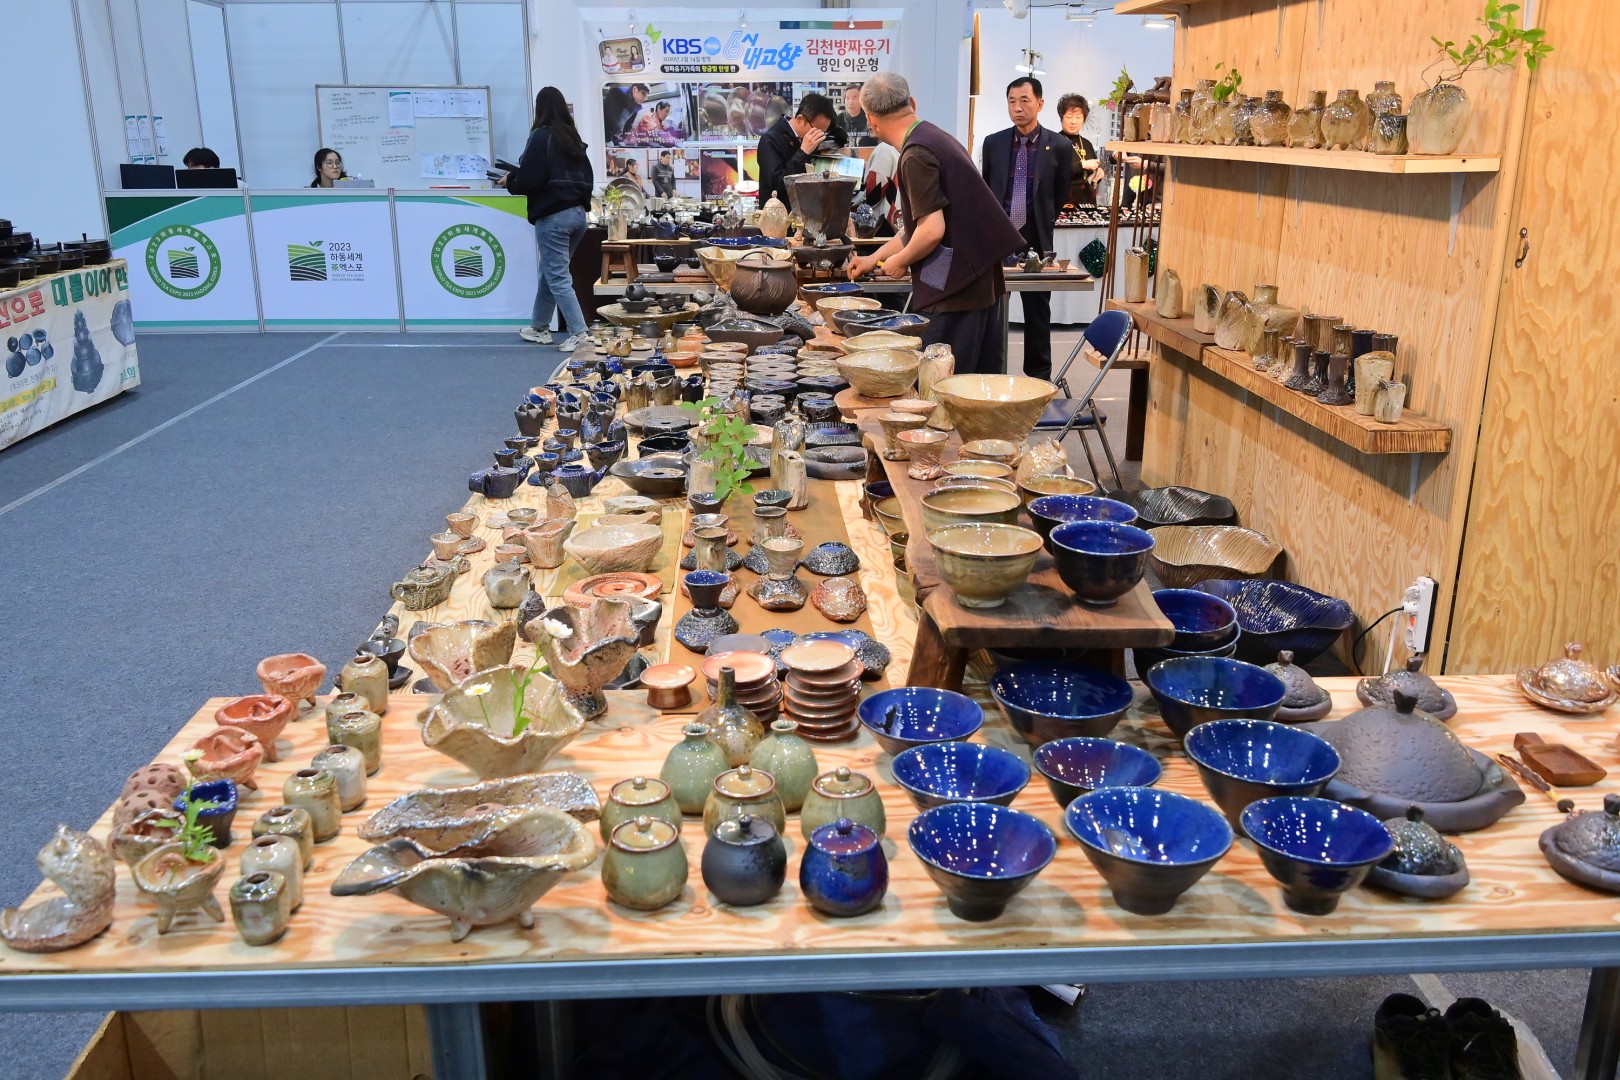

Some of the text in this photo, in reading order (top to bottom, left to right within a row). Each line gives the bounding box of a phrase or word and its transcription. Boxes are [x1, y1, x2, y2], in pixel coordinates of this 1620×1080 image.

[662, 38, 702, 55] KBS
[806, 38, 890, 56] 김천방짜유기
[743, 42, 803, 71] 내고향
[817, 57, 880, 73] 명인 이운형
[329, 242, 352, 252] 2023
[330, 252, 363, 262] 하동세계
[150, 266, 162, 284] WORLD
[161, 282, 169, 291] TEA
[169, 287, 182, 297] EXPO
[435, 265, 446, 282] WORLD
[444, 280, 453, 290] TEA
[452, 286, 465, 295] EXPO
